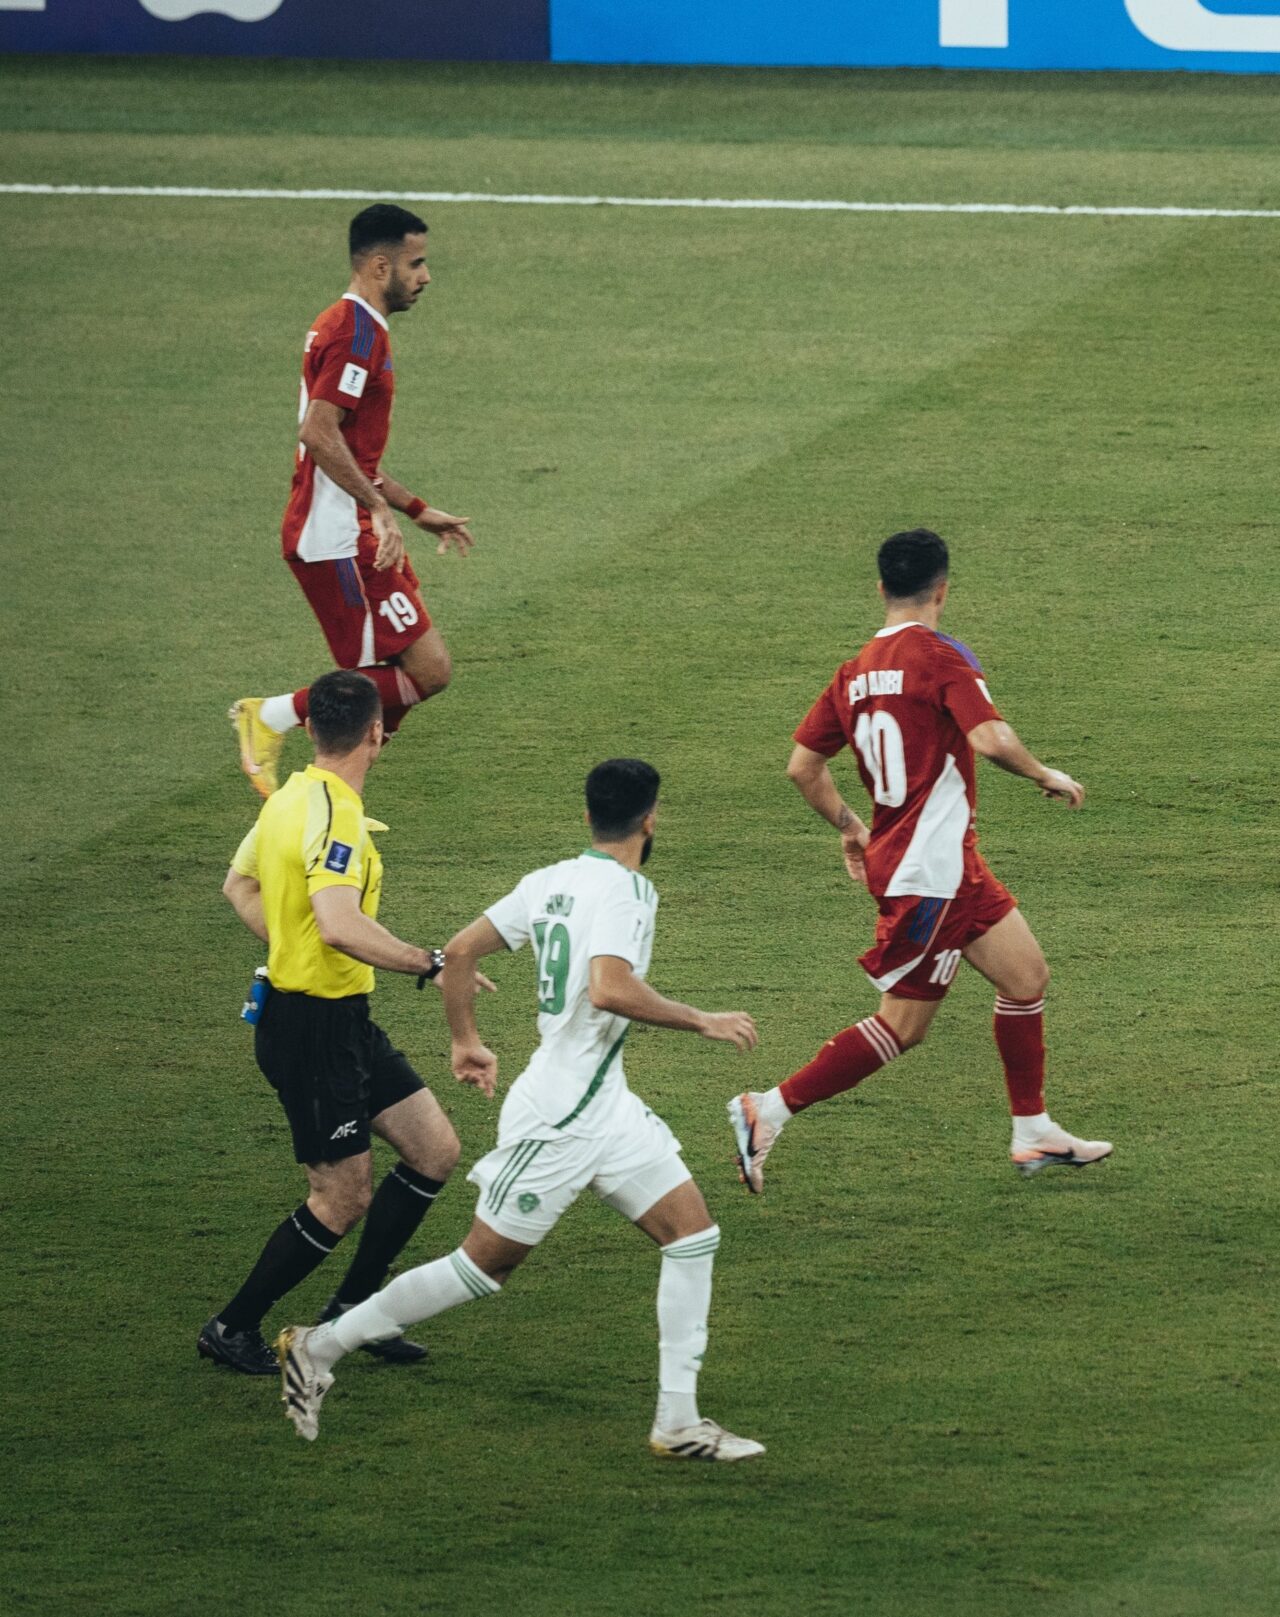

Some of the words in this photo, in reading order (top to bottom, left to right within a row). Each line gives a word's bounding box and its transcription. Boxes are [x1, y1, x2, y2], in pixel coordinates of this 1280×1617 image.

[378, 591, 419, 634] 19
[853, 709, 908, 808] 10
[532, 921, 571, 1016] 19
[928, 948, 962, 986] 10
[330, 1120, 358, 1140] AFC
